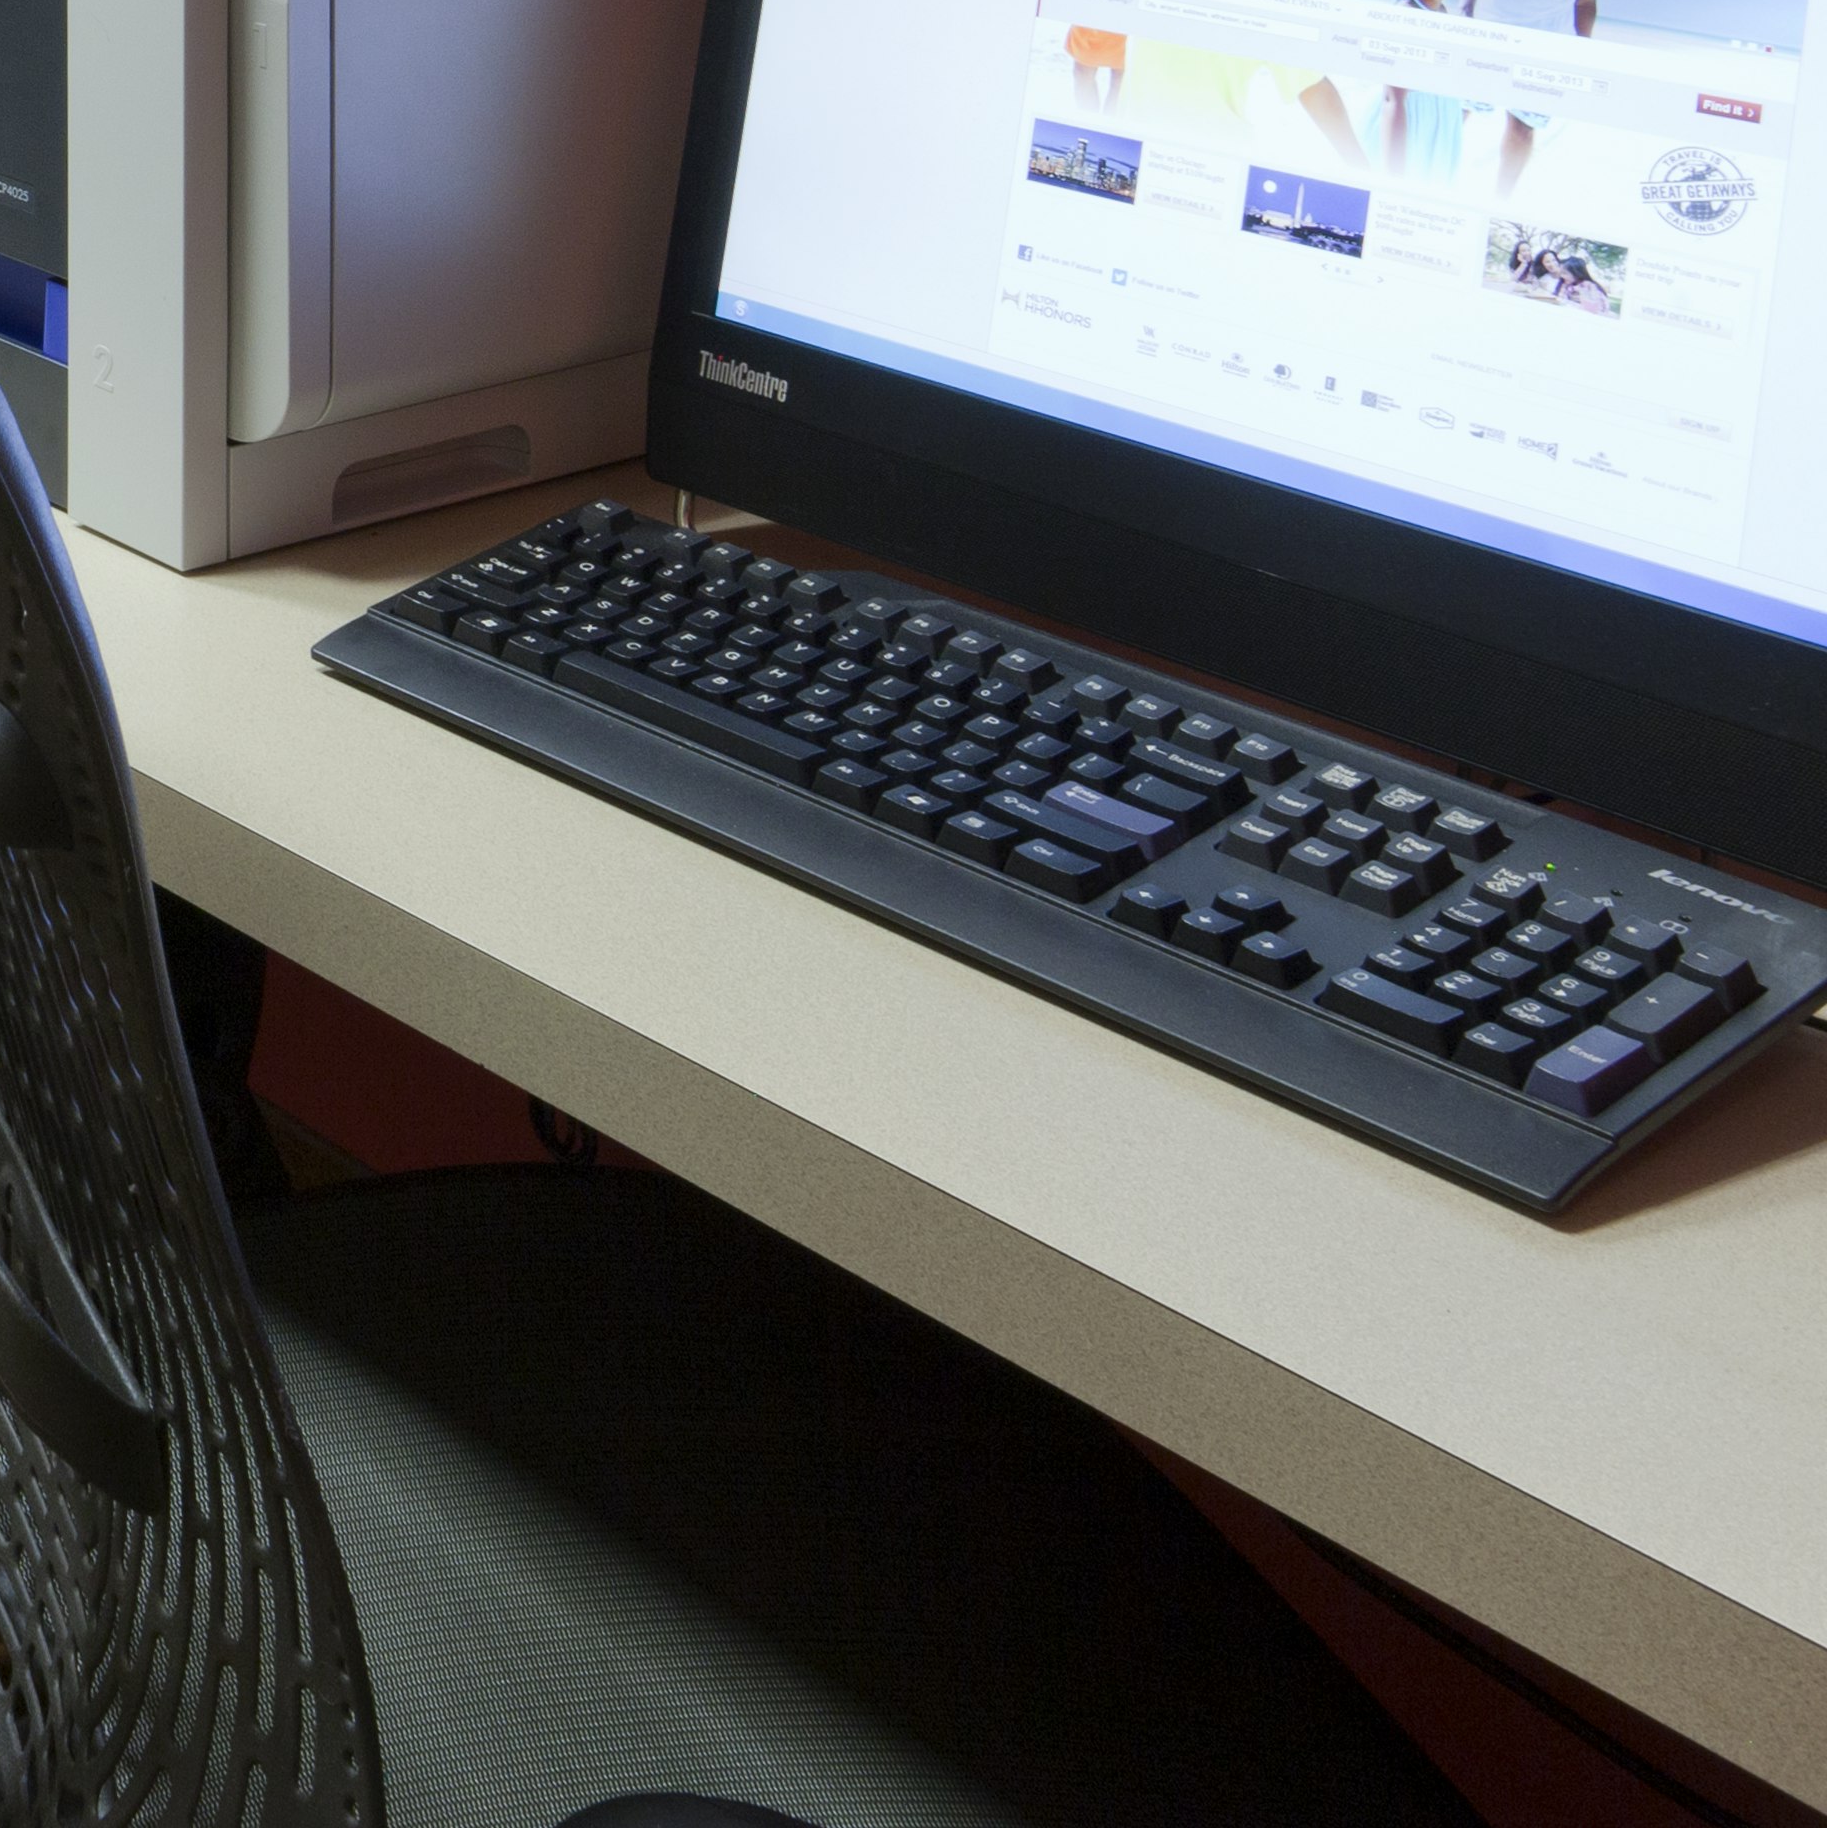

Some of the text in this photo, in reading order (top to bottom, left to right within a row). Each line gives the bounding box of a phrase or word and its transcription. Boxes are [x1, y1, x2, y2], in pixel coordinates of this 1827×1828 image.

[1536, 69, 1555, 83] Sep
[1558, 75, 1584, 88] 2013
[1702, 98, 1731, 114] Find
[1662, 150, 1707, 168] TRAVEL
[1640, 182, 1756, 201] GREAT GETAWAYS
[1666, 210, 1717, 233] CALLING
[1026, 291, 1060, 308] HILTON
[1024, 300, 1093, 330] HHONORS
[91, 343, 115, 394] 2
[699, 349, 789, 404] ThinkCentre
[578, 561, 595, 573] Q
[620, 576, 641, 589] W
[554, 584, 571, 595] A
[659, 592, 678, 603] E
[597, 600, 613, 611] S
[702, 609, 720, 620] R
[637, 616, 654, 626] D
[580, 623, 599, 634] X
[747, 625, 763, 636] T
[679, 632, 698, 643] F
[625, 641, 642, 652] C
[794, 642, 808, 654] Y
[724, 651, 741, 661] G
[670, 659, 687, 670] V
[836, 660, 855, 671] U
[768, 668, 788, 679] H
[711, 675, 730, 686] B
[756, 693, 775, 704] N
[933, 697, 951, 708] O
[862, 704, 881, 716] K
[803, 713, 825, 724] M
[981, 715, 1000, 726] P
[911, 724, 923, 735] L
[1246, 739, 1268, 751] F12
[1647, 869, 1796, 925] lenovo
[1463, 898, 1479, 908] 7
[1524, 924, 1542, 936] 8
[1489, 951, 1509, 963] 5
[1593, 951, 1611, 963] 9
[1567, 1044, 1608, 1063] Enter
